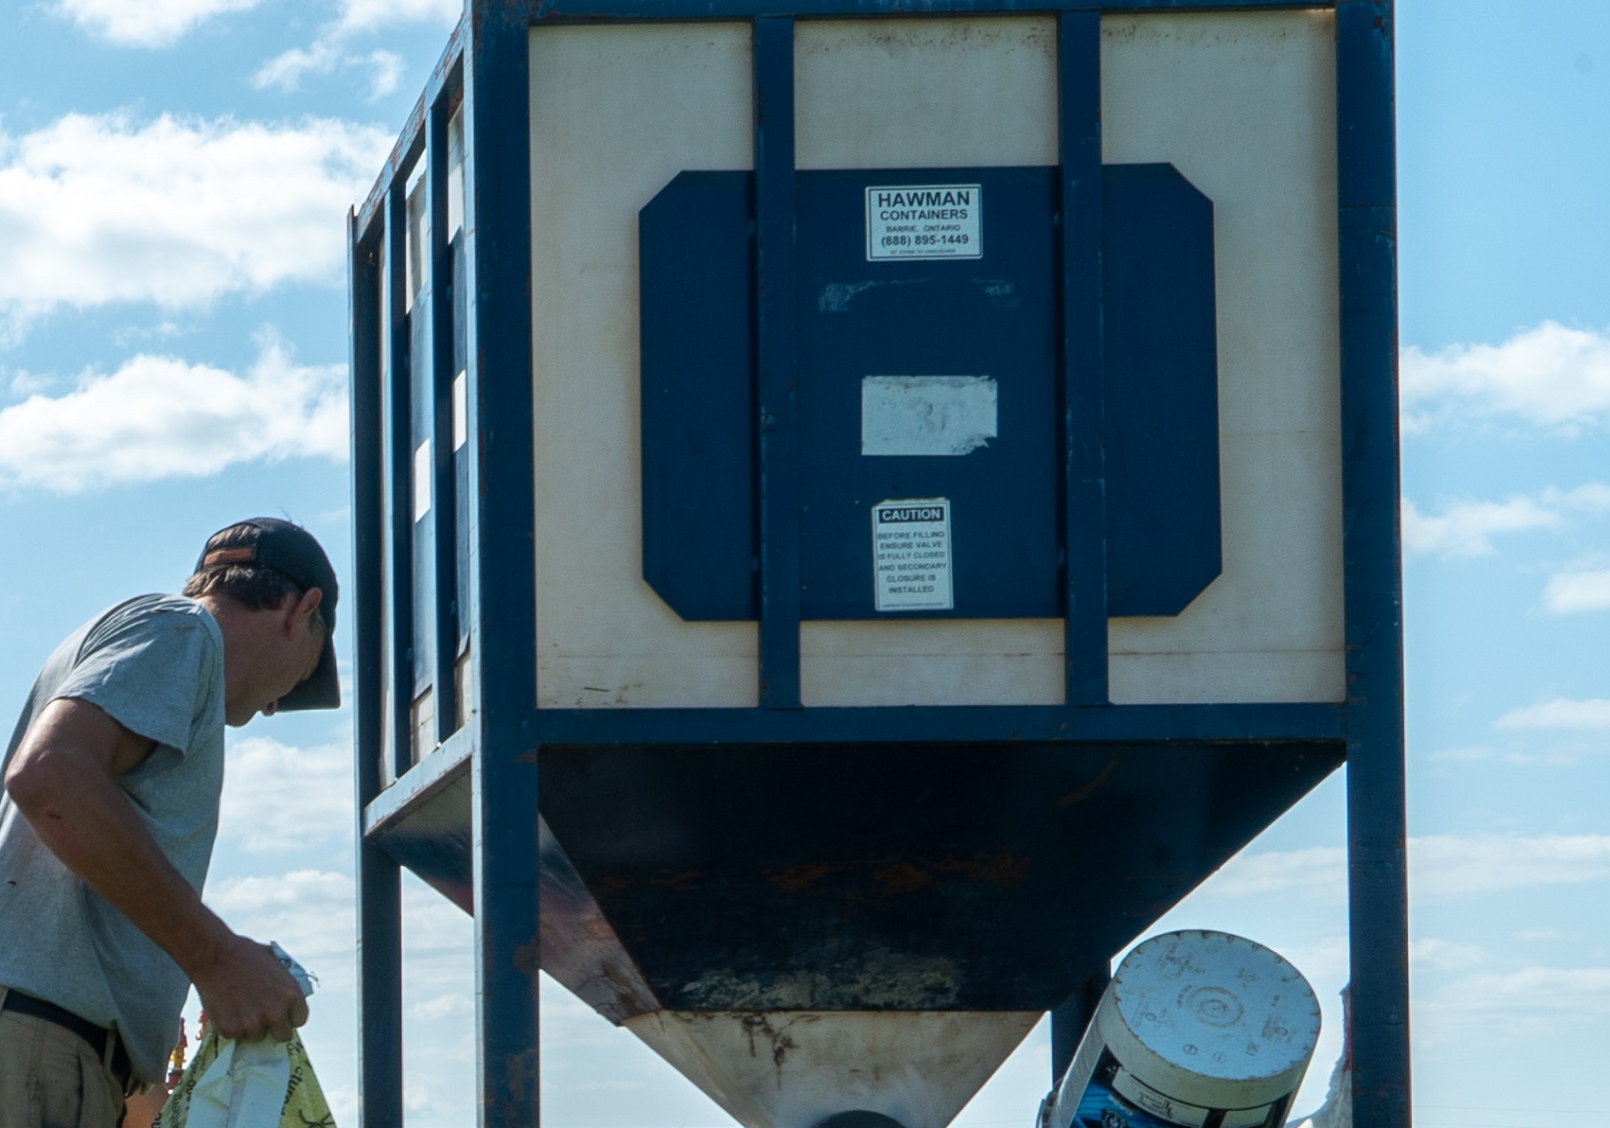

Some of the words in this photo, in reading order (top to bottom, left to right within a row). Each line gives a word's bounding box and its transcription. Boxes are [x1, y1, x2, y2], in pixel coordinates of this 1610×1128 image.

[878, 190, 970, 207] HAWMAN
[880, 209, 968, 221] CONTAINERS
[924, 224, 961, 232] ONTARIO
[881, 235, 911, 247] (888)
[915, 234, 969, 245] 895-1449
[882, 509, 941, 521] CAUTION
[878, 532, 910, 540] BEFORE
[913, 531, 945, 539] FILLING
[880, 542, 913, 550] ENSURE
[898, 562, 947, 570] SECONDARY
[886, 574, 926, 582] CLOSURE
